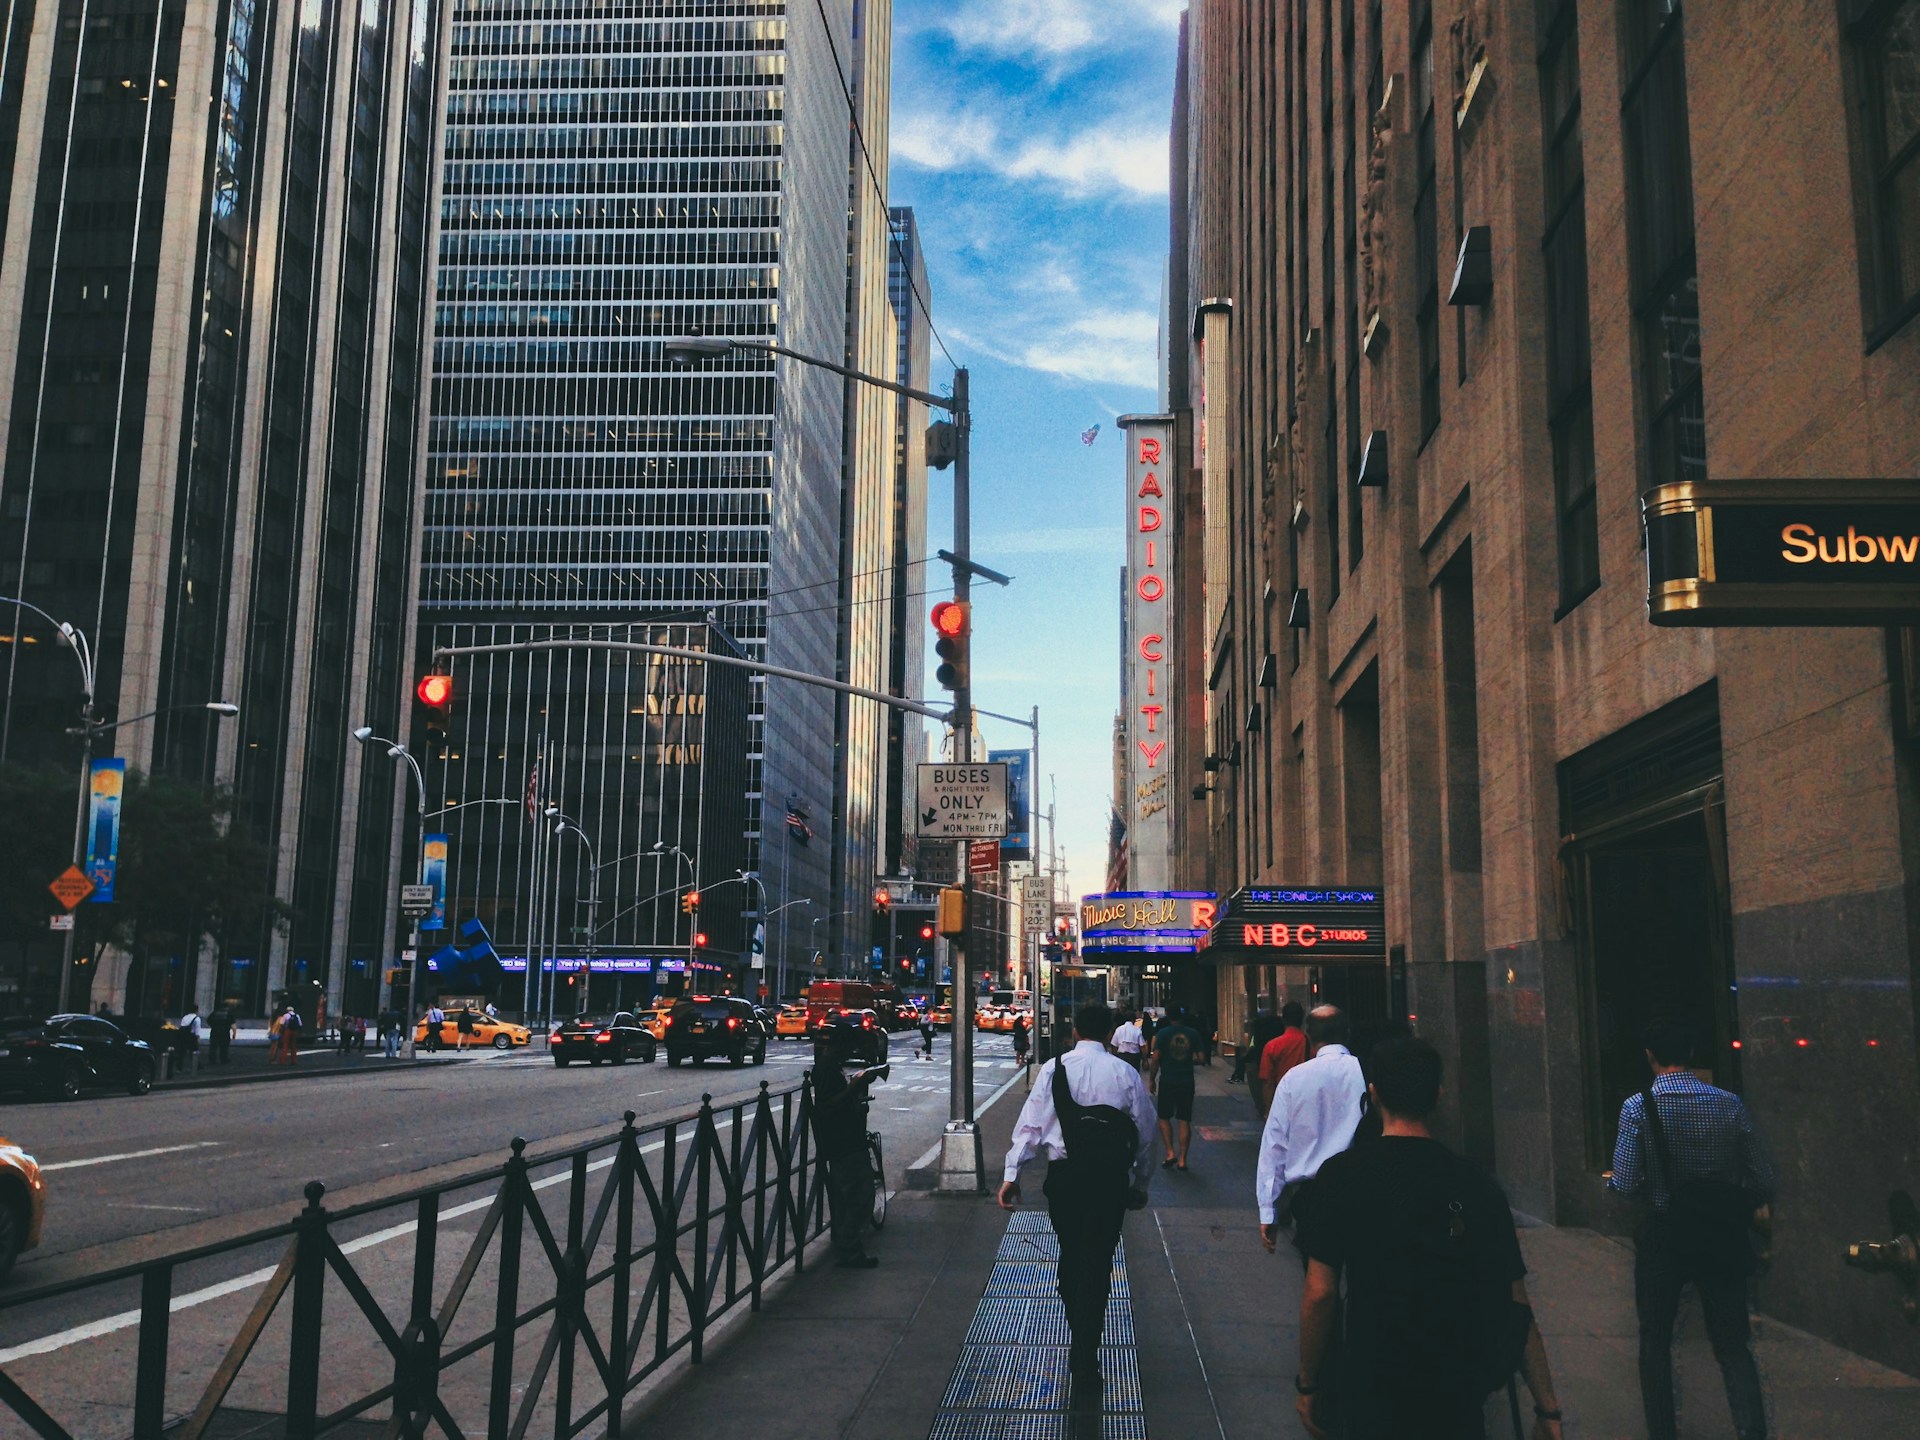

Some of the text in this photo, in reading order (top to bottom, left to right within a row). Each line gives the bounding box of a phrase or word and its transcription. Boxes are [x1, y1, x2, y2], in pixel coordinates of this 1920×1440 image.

[1781, 523, 1920, 563] Subw
[1137, 437, 1166, 768] RADIO CITY
[934, 769, 990, 784] BUSES
[966, 785, 991, 793] TURNS
[940, 795, 984, 809] ONLY
[943, 824, 962, 833] MON
[988, 823, 1003, 832] FRI
[1029, 880, 1044, 888] BUS
[1027, 890, 1047, 898] LANE
[1251, 890, 1375, 902] THE TONIGHT SHOW
[1083, 898, 1179, 930] Music Hall
[1243, 923, 1369, 947] NBC STUDIOS
